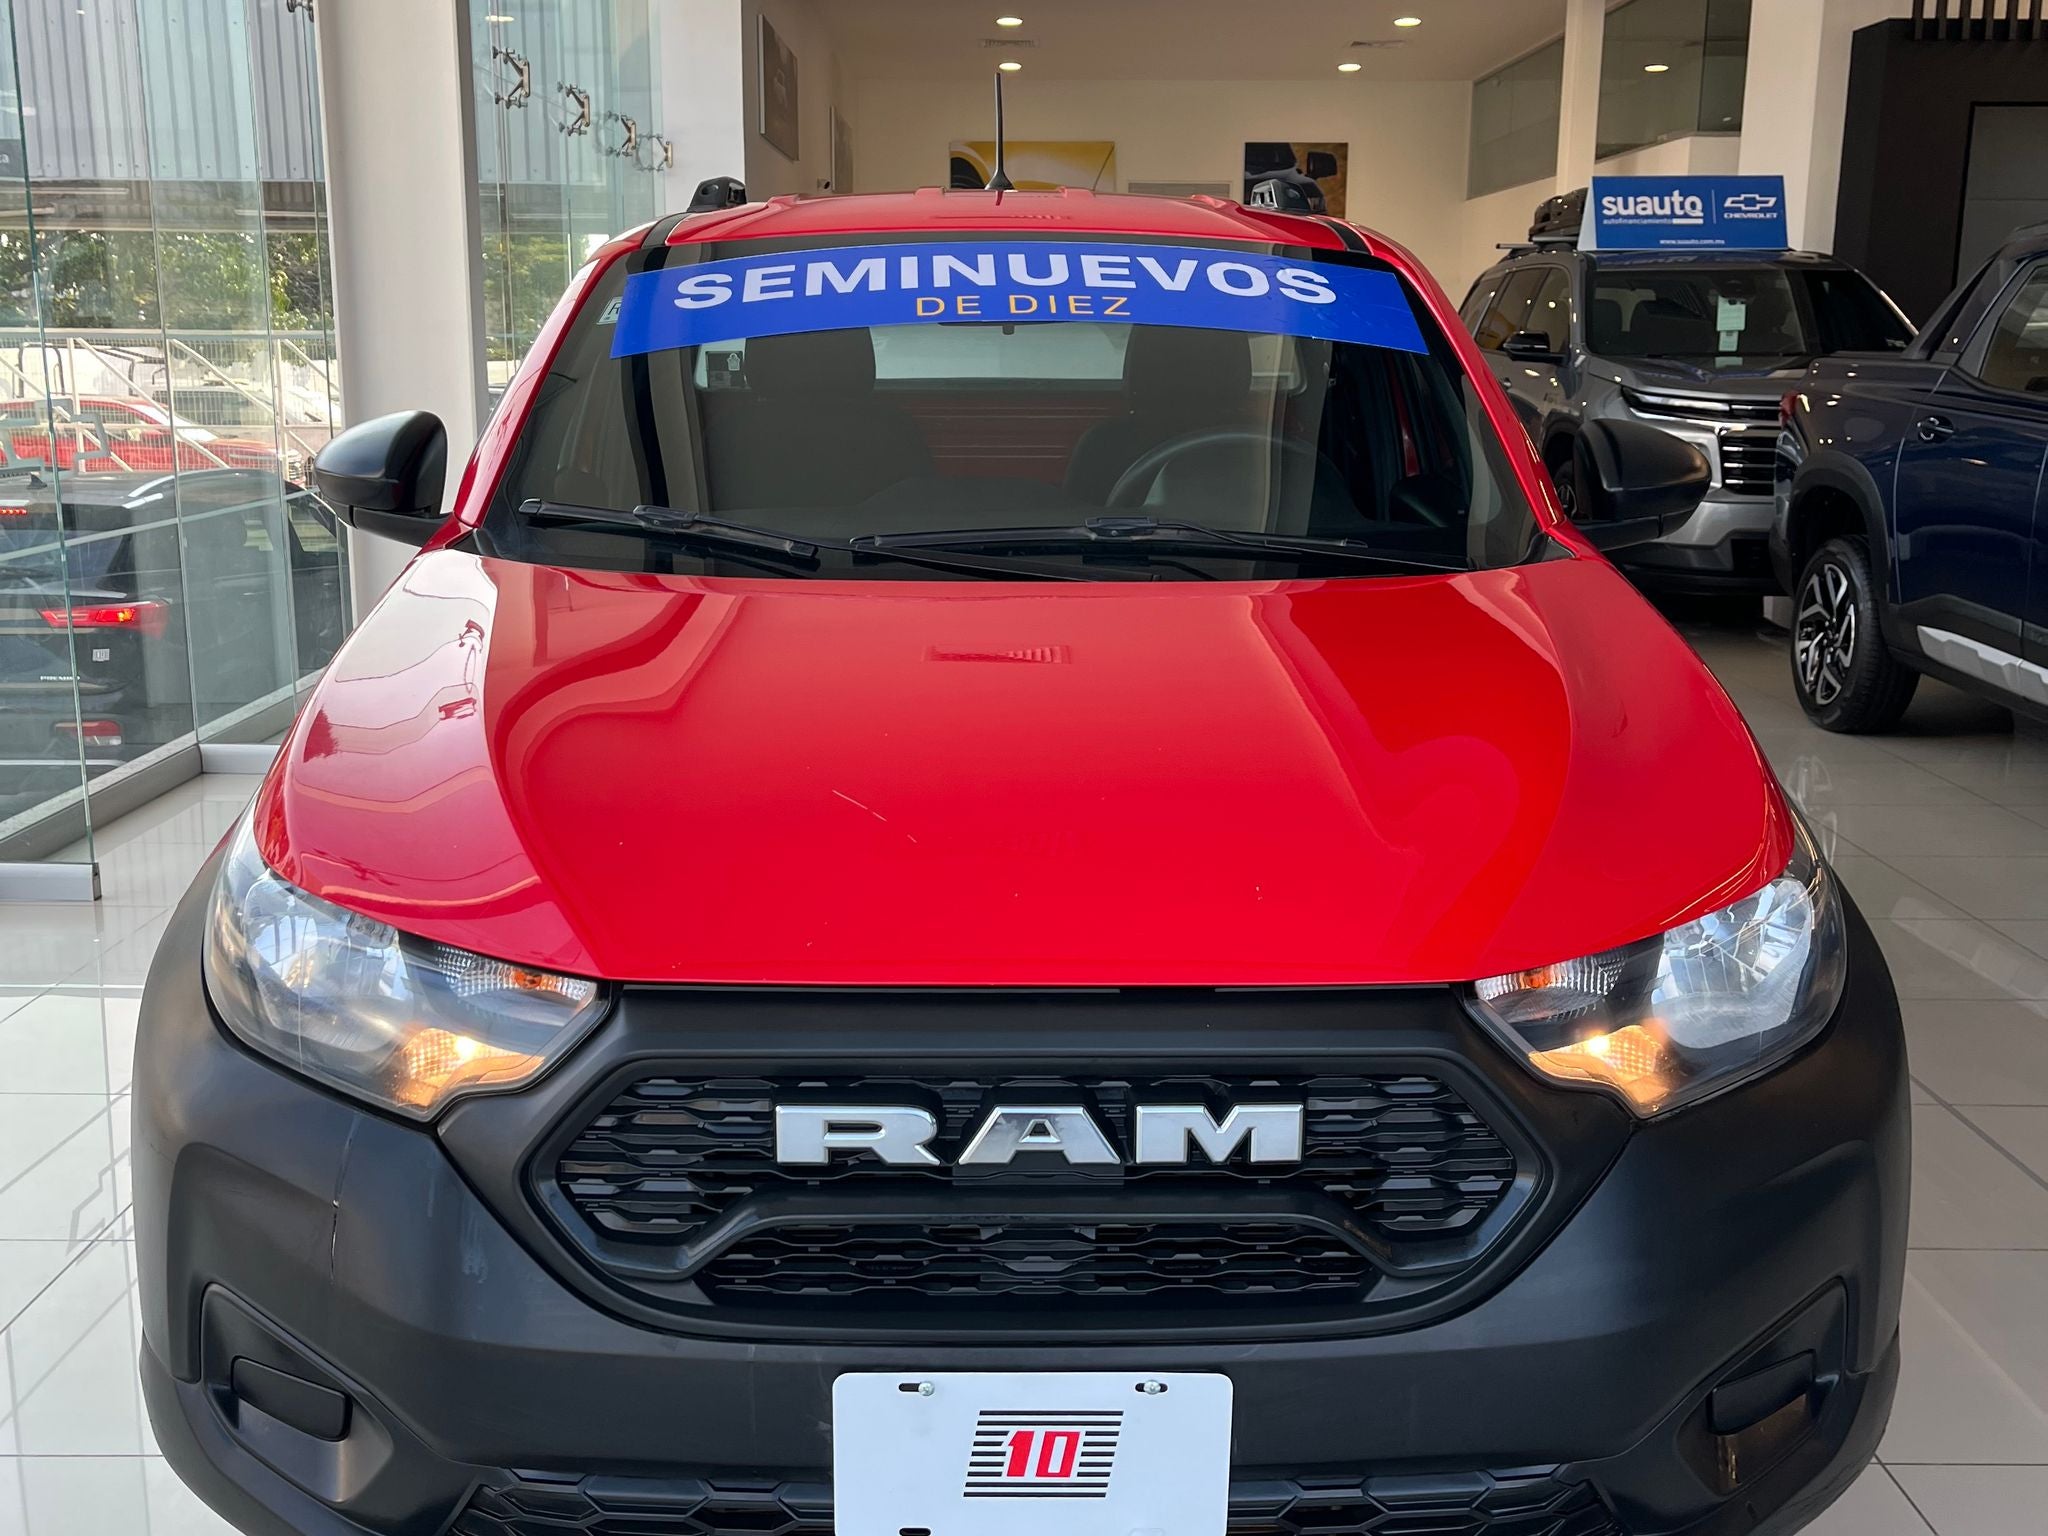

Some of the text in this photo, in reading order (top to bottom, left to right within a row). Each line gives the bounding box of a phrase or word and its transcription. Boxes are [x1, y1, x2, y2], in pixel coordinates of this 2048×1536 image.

[1602, 189, 1704, 217] suauto
[673, 253, 1338, 309] SEMINUEVOS
[916, 294, 1131, 316] DE DIEZ
[775, 1104, 1304, 1165] RAM
[1007, 1430, 1081, 1478] 10
